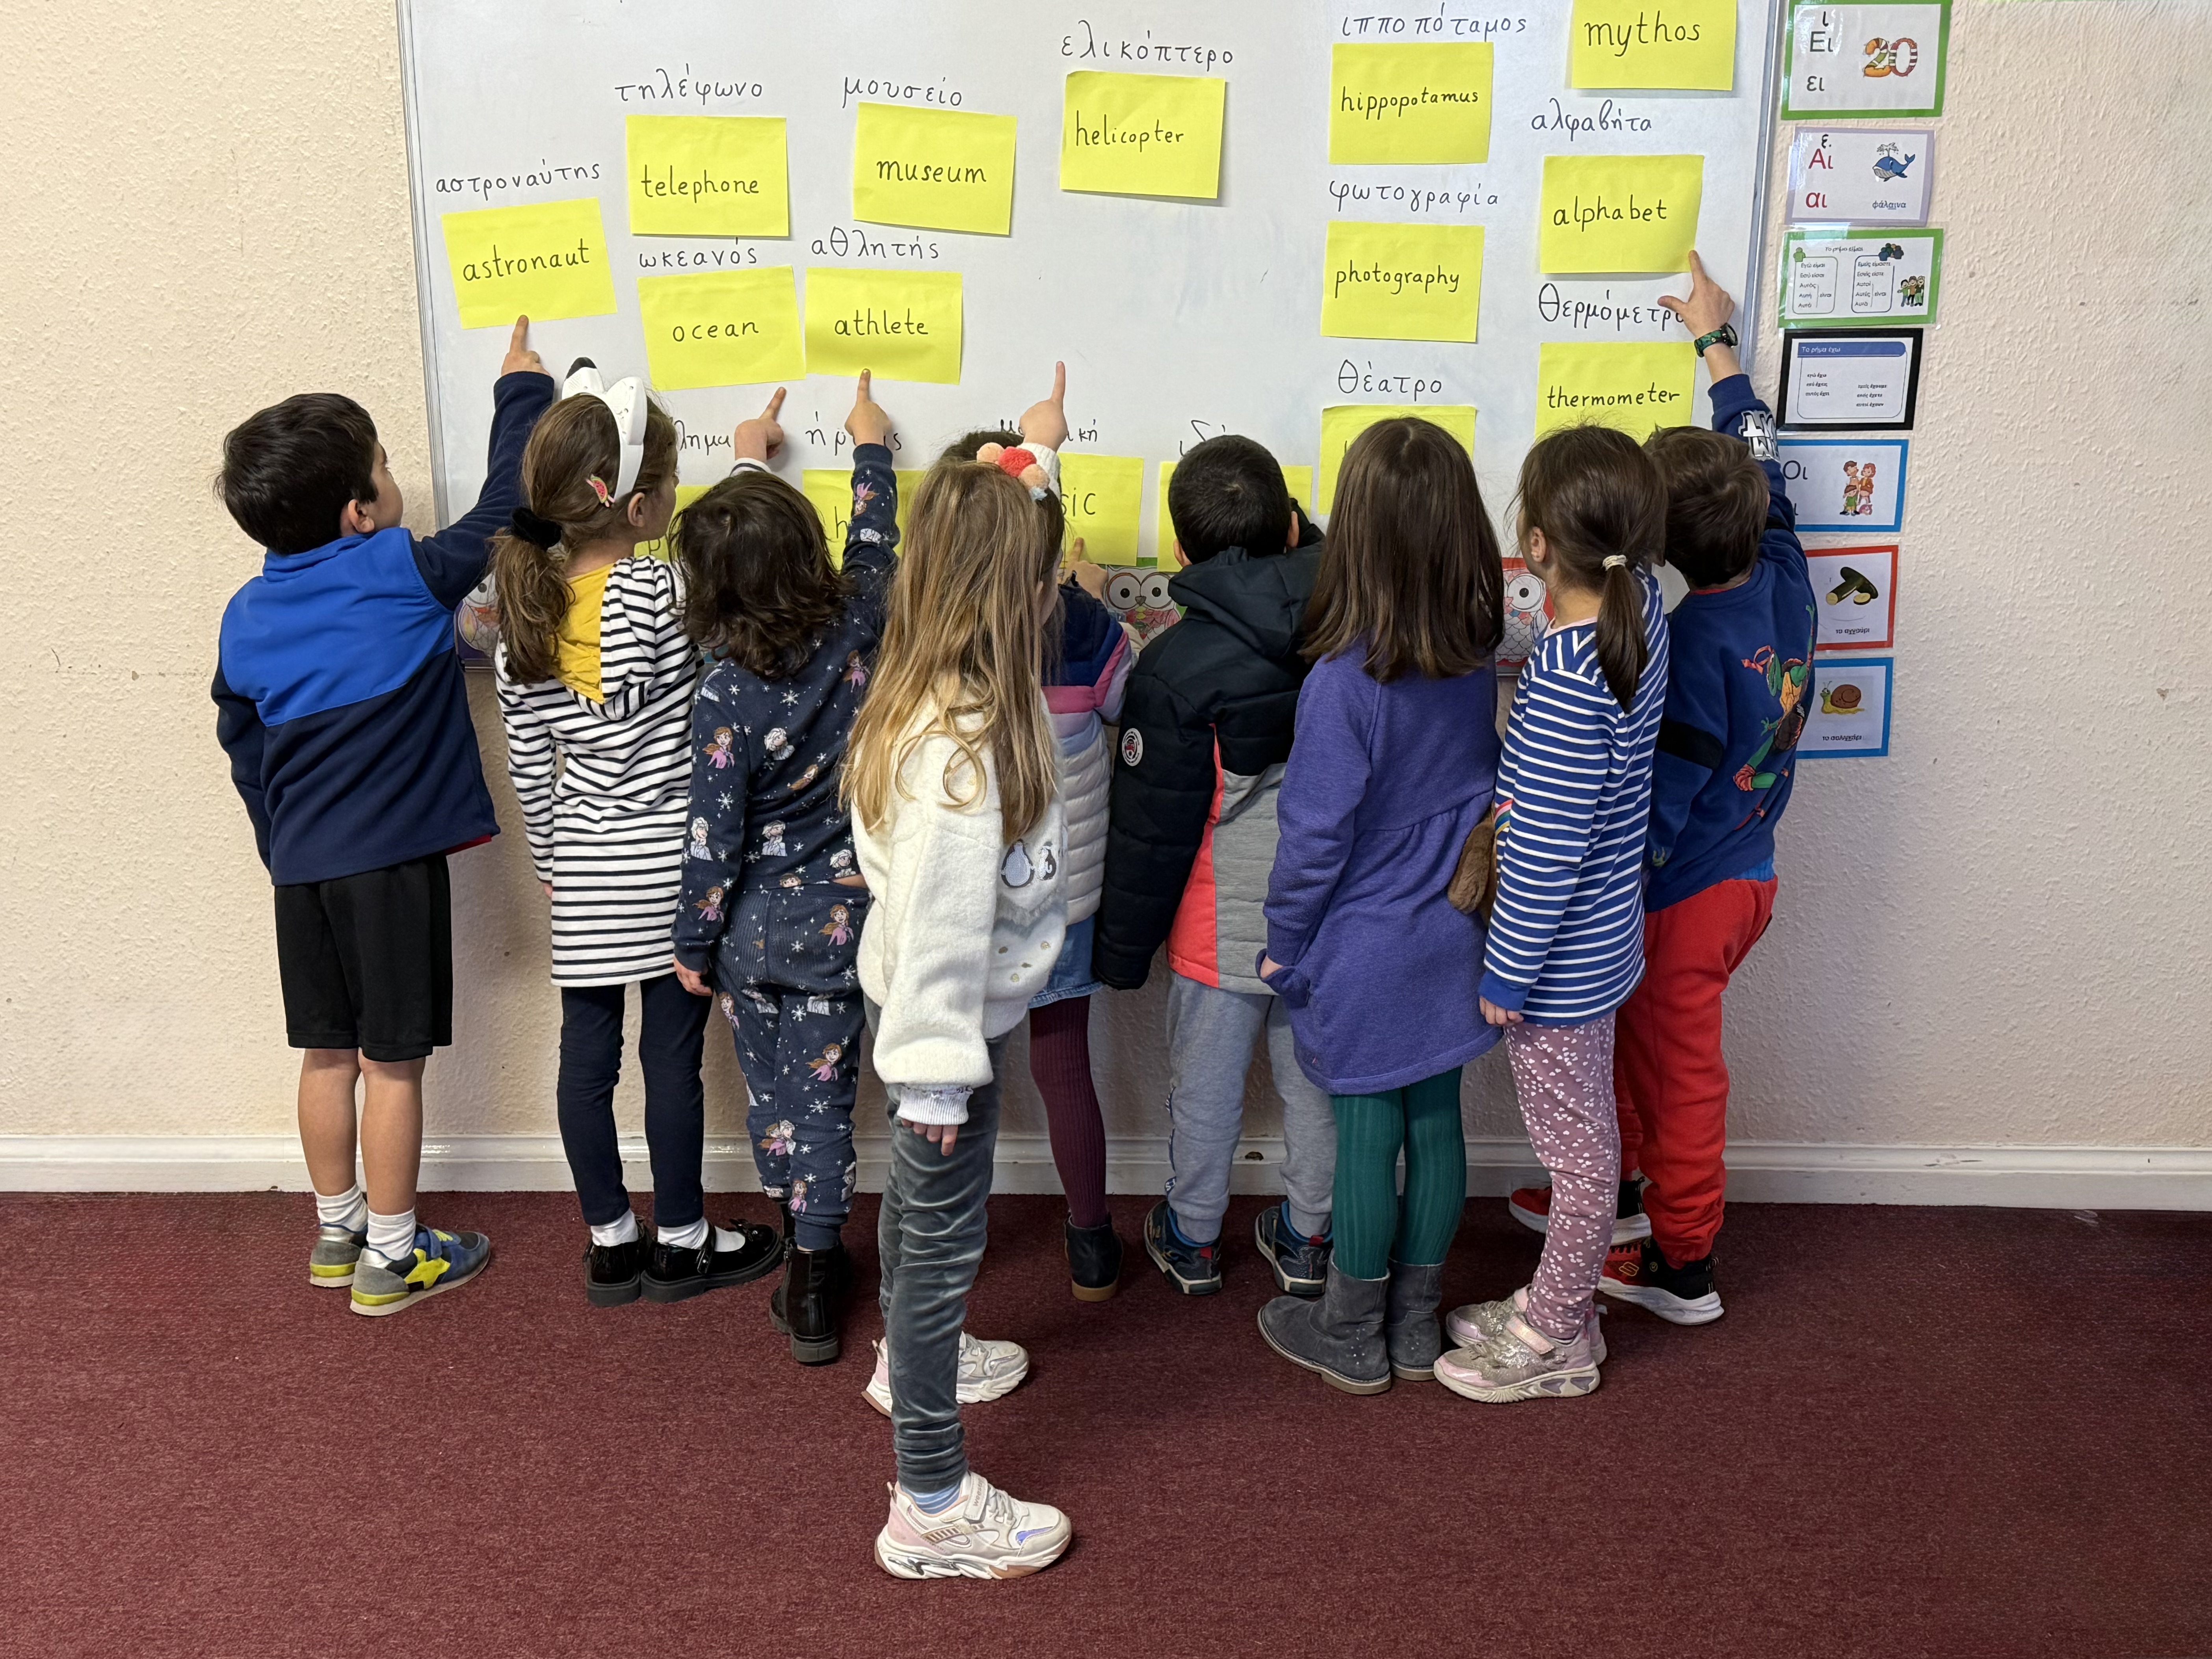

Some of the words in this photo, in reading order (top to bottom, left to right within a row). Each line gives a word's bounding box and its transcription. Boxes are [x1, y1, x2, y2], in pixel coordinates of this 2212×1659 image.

[1062, 20, 1232, 70] ελικόπτερο
[1584, 10, 1700, 57] mythos
[1863, 37, 1918, 77] 20
[615, 63, 762, 105] τηλέφωνο
[842, 76, 962, 108] μουσείο
[1342, 86, 1478, 120] hippopotamus
[1076, 110, 1184, 152] helicopter
[436, 159, 599, 201] αστροναύτης
[641, 165, 759, 203] telephone
[877, 161, 986, 183] museum
[1329, 181, 1498, 212] φωτογραφία
[1554, 194, 1666, 232] alphabet
[1872, 201, 1906, 210] φάλαινα
[463, 238, 589, 281] astronaut
[639, 237, 758, 267] ωκεανός
[812, 227, 939, 259] αθλητής
[1335, 260, 1459, 298] photography
[673, 322, 758, 342] ocean
[835, 308, 928, 336] athlete
[1547, 382, 1680, 408] thermometer
